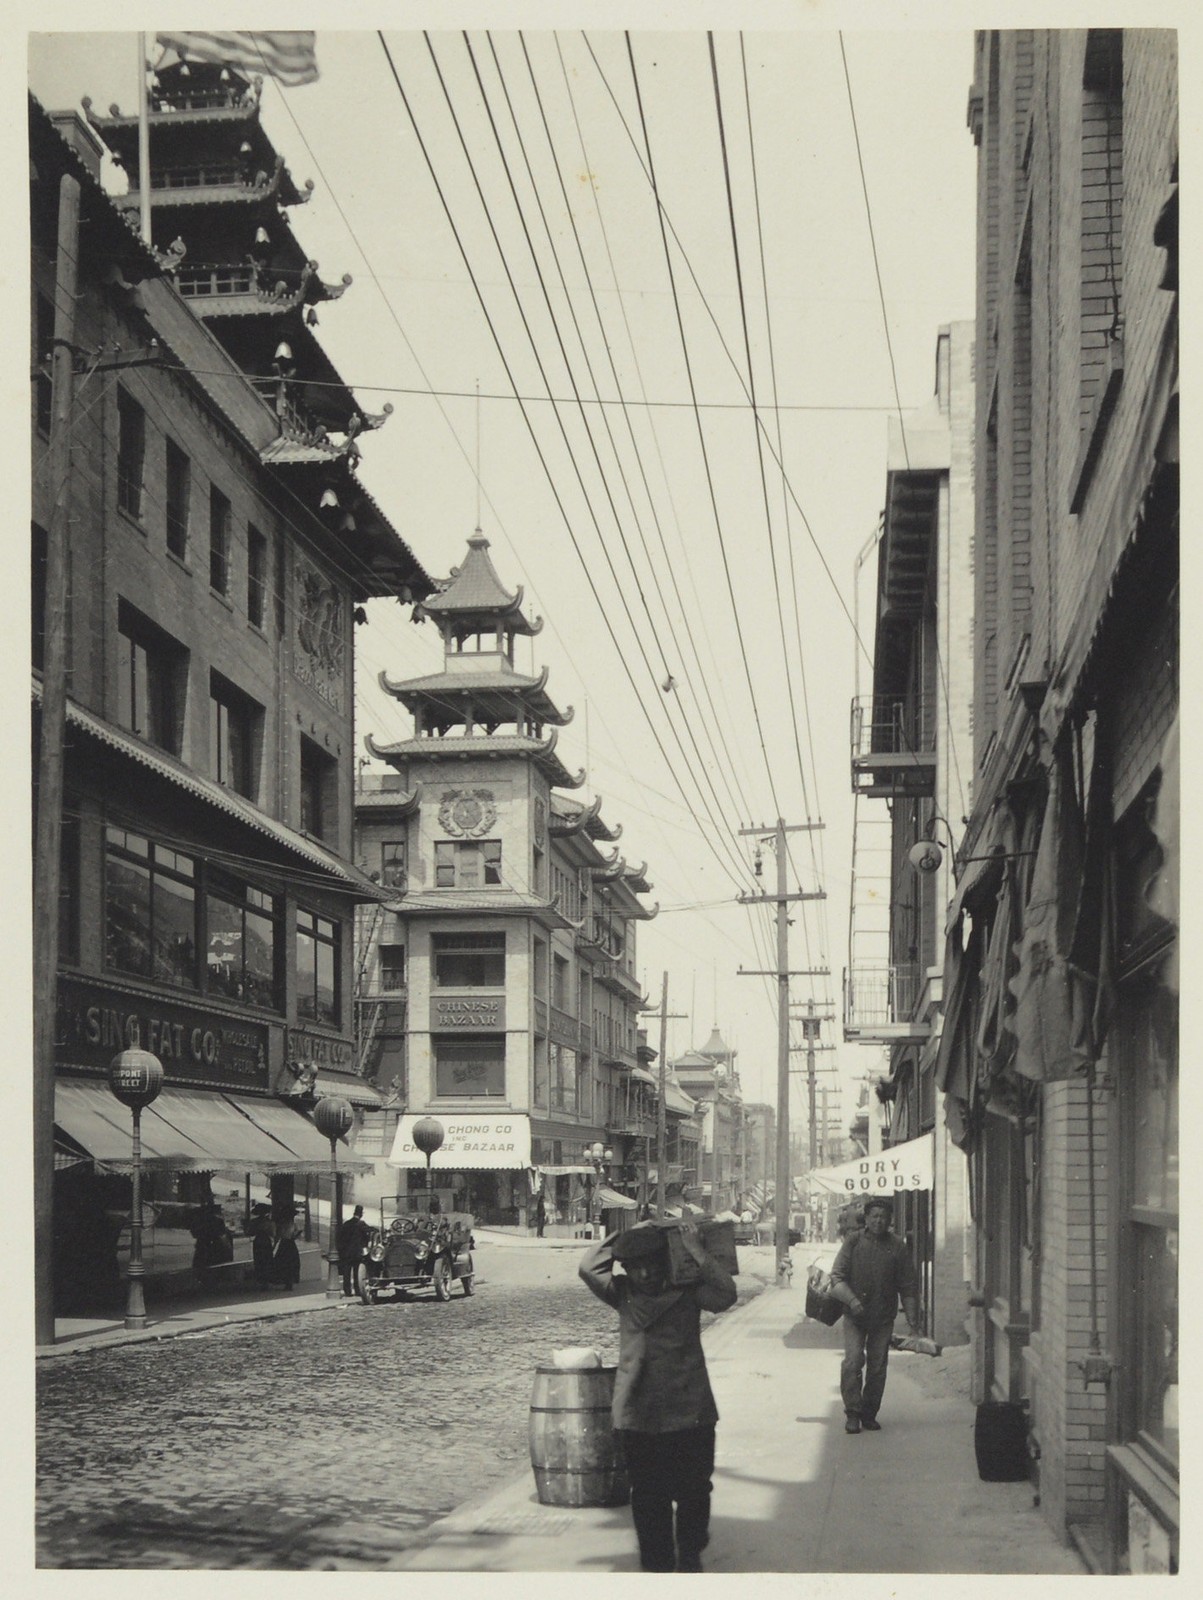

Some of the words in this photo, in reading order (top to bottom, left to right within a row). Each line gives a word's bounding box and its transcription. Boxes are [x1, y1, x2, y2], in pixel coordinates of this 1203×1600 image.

[436, 1001, 498, 1012] CHINESE
[439, 1015, 497, 1026] BAZAAR
[86, 1006, 140, 1049] SING
[148, 1018, 184, 1058] FAT
[448, 1125, 490, 1134] CHONG
[495, 1125, 512, 1134] CO
[402, 1143, 456, 1152] CHSE
[463, 1143, 515, 1152] BAZAAR
[860, 1159, 900, 1174] DRY
[845, 1174, 921, 1191] GOODS
